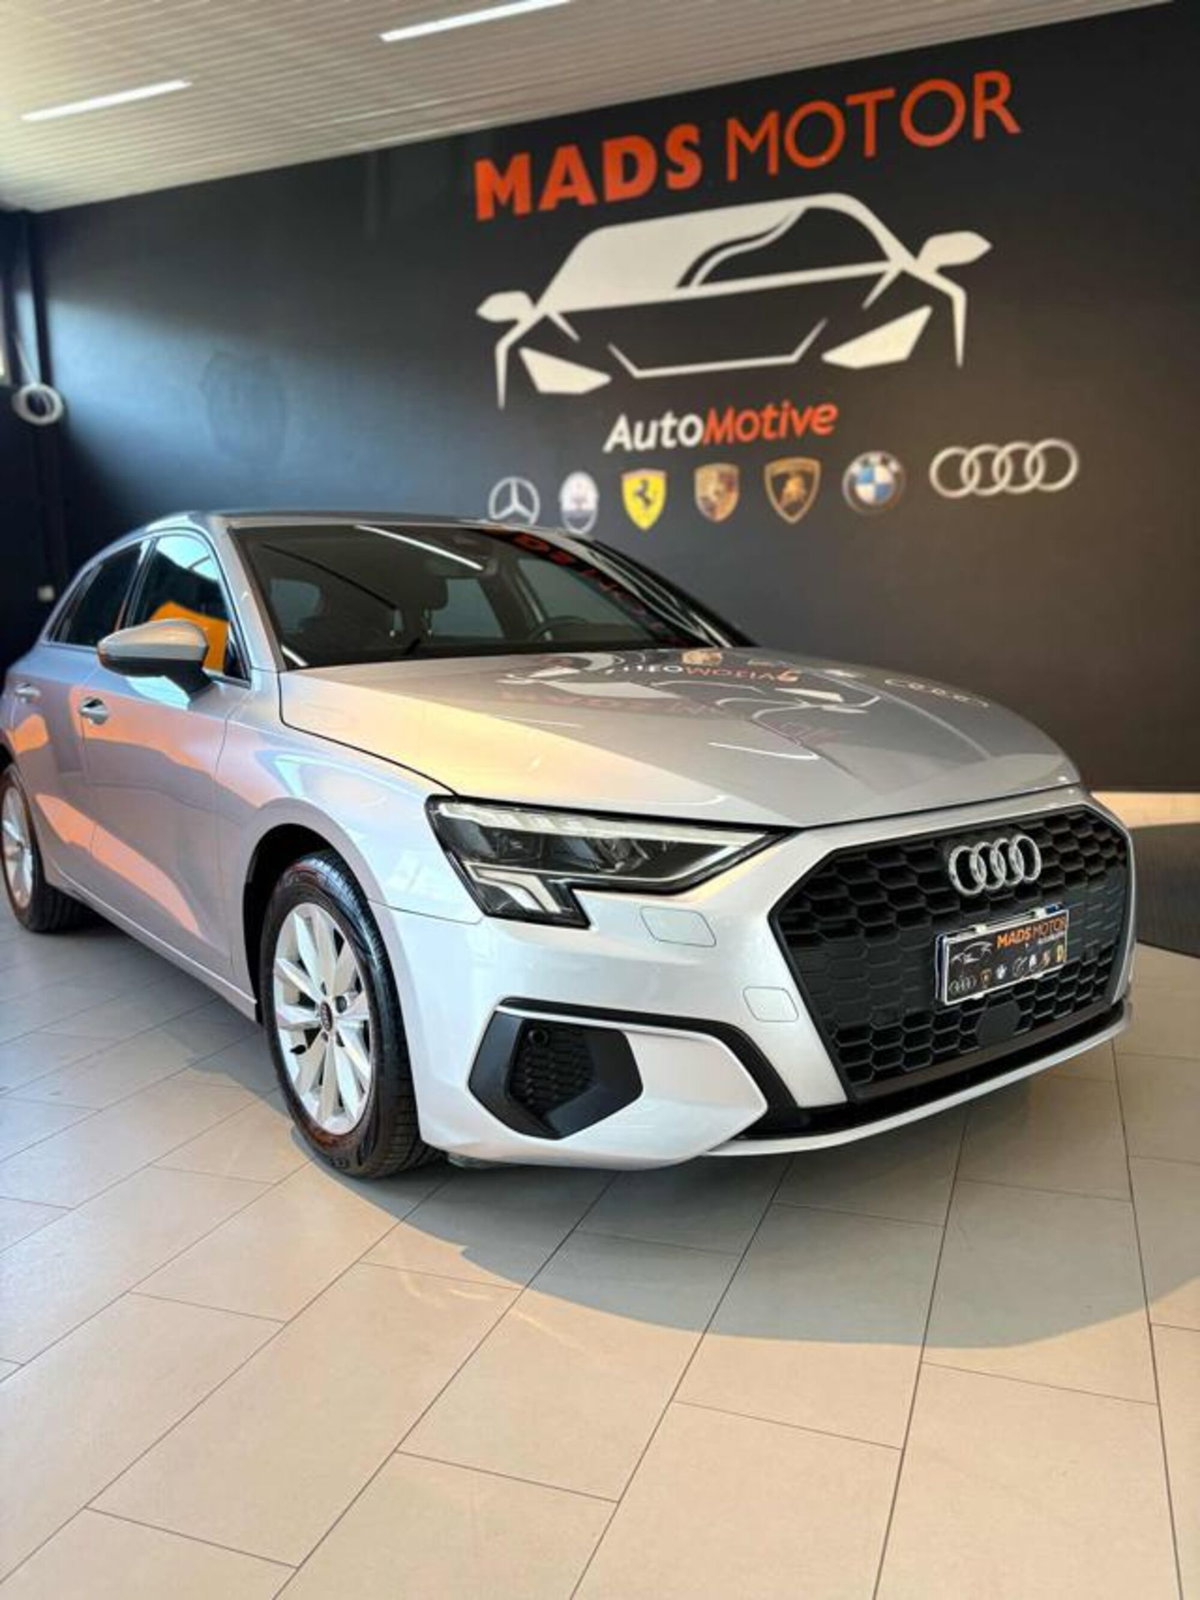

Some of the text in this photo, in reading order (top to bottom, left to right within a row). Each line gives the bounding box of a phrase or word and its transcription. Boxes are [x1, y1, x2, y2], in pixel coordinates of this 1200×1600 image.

[474, 71, 1020, 220] MADS MOTOR
[603, 400, 839, 453] AutoMotive
[997, 928, 1032, 949] MADS
